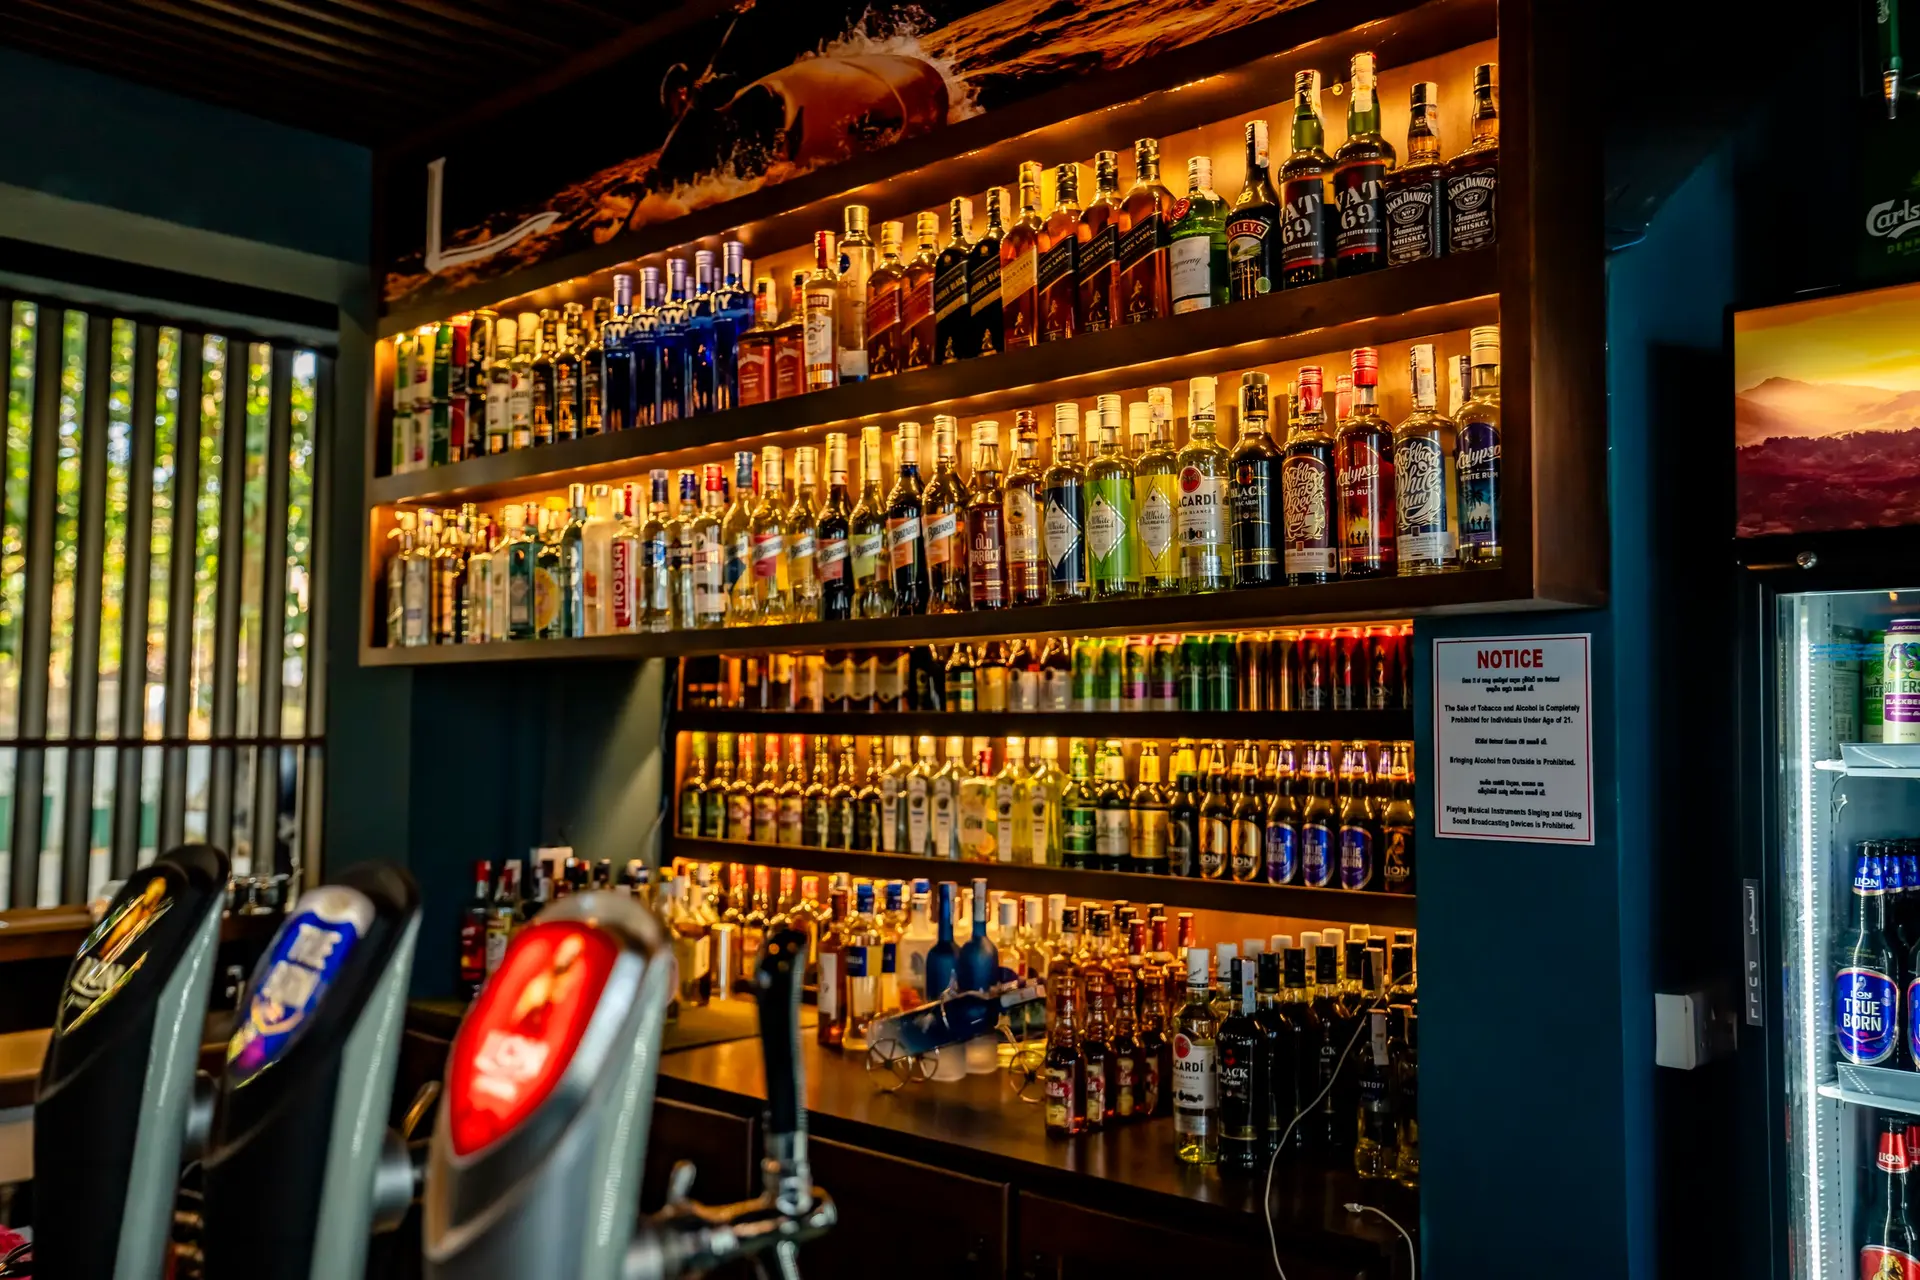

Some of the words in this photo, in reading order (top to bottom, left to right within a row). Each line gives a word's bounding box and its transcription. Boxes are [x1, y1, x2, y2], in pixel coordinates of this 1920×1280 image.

[1448, 181, 1466, 200] JACK
[1466, 177, 1496, 190] DANIEL'S
[1334, 180, 1384, 212] VAT
[1386, 196, 1404, 214] JACK
[1403, 192, 1433, 204] DANIEL'S
[1341, 204, 1375, 230] 69
[1228, 223, 1262, 236] AILEYS
[1282, 218, 1312, 244] 69
[1454, 219, 1490, 233] WHISKEY
[1392, 233, 1428, 246] WHISKEY
[1120, 243, 1134, 257] LACK
[1079, 254, 1094, 268] LACK
[1460, 472, 1480, 482] WHITE
[1179, 490, 1218, 508] ACARDÍ
[1231, 486, 1268, 498] BLACK
[976, 533, 992, 550] OLD
[1477, 648, 1544, 669] NOTICE
[1884, 680, 1920, 694] SOERS
[1444, 704, 1456, 712] The
[1456, 704, 1469, 712] Sale
[1470, 704, 1476, 712] of
[1478, 704, 1502, 712] Tobacco
[1504, 704, 1514, 712] and
[1516, 704, 1538, 712] Alcohol
[1539, 704, 1544, 712] is
[1546, 704, 1580, 712] Completely
[1451, 716, 1480, 724] Prohibited
[1481, 716, 1489, 724] for
[1490, 716, 1522, 724] Individuals
[1524, 716, 1541, 724] Under
[1542, 716, 1554, 725] Age
[1556, 716, 1562, 724] of
[1564, 716, 1573, 724] 21.
[1450, 756, 1473, 765] Bringing
[1543, 758, 1576, 766] Prohibited.
[1446, 806, 1466, 814] Playing
[1468, 806, 1490, 814] Musical
[1491, 808, 1526, 816] Instruments
[1528, 809, 1550, 818] Singing
[1564, 810, 1582, 820] Using
[1472, 818, 1510, 828] Broadcasting
[1510, 820, 1534, 828] Devices
[1542, 822, 1576, 830] Prohibited.
[1384, 866, 1410, 876] LION
[1854, 877, 1880, 888] LION
[1748, 961, 1758, 1018] PULL
[1851, 990, 1872, 1000] LON
[1844, 998, 1880, 1016] TRUE
[1844, 1013, 1882, 1032] BORN
[1173, 1059, 1204, 1073] CARDÍ
[1220, 1068, 1248, 1079] LACK
[1878, 1152, 1905, 1164] LION
